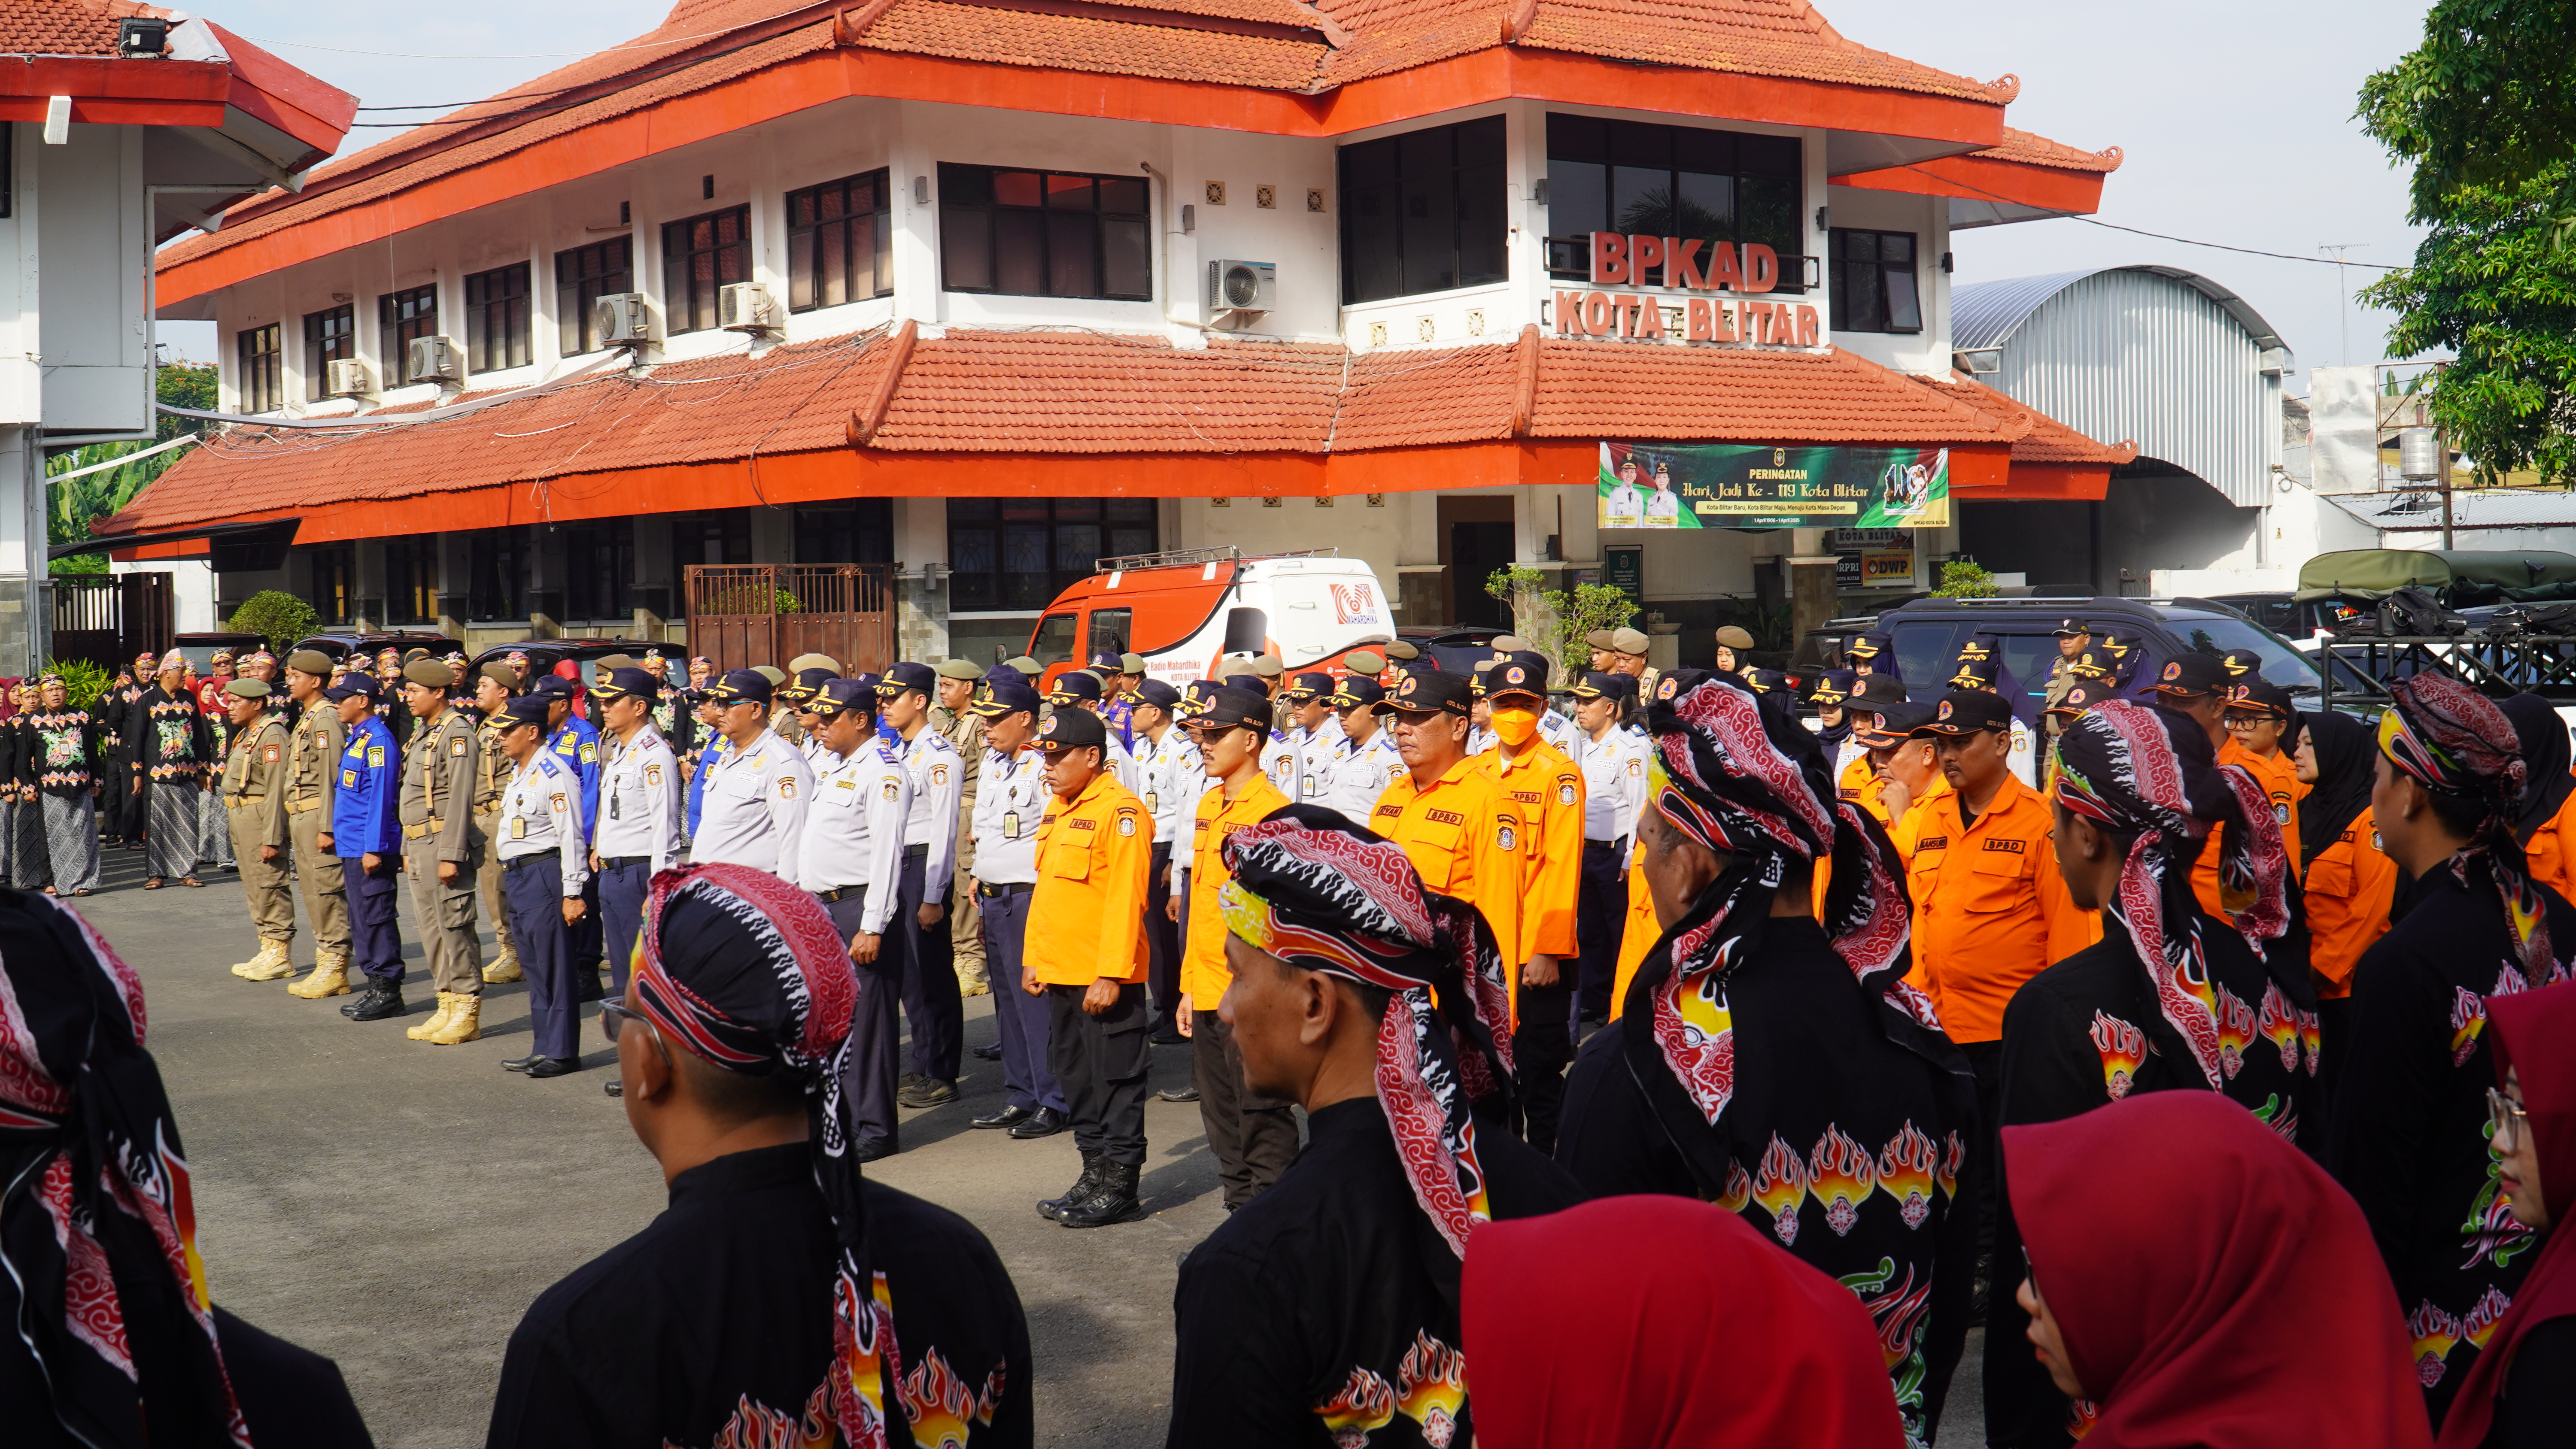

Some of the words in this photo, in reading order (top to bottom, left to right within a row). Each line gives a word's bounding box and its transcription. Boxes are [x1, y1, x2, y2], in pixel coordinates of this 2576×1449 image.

[1590, 231, 1779, 293] BPKAD
[1555, 290, 1666, 338] KOTA
[1684, 298, 1819, 346] BLITAR
[1749, 469, 1807, 480] PERINGATAN
[1683, 482, 1710, 497] Hari
[1710, 482, 1742, 501] Jadi
[1747, 483, 1763, 497] Ke
[1778, 483, 1795, 497] 119
[1800, 483, 1829, 497] Kota
[1833, 483, 1869, 497] Blitar
[1839, 532, 1864, 541] KOTA
[1868, 531, 1902, 541] BLITAR
[1878, 560, 1908, 574] DWP
[1346, 615, 1379, 624] MAHARDHIKA
[1151, 662, 1166, 671] Radio
[1167, 660, 1200, 670] Mahardhika
[1171, 673, 1183, 682] KOTA
[1184, 673, 1200, 681] BLITAR
[837, 781, 855, 790] DISHUB
[1431, 811, 1458, 822] BPBD
[1073, 820, 1092, 828] BPBD
[1988, 841, 2018, 850] BPBD
